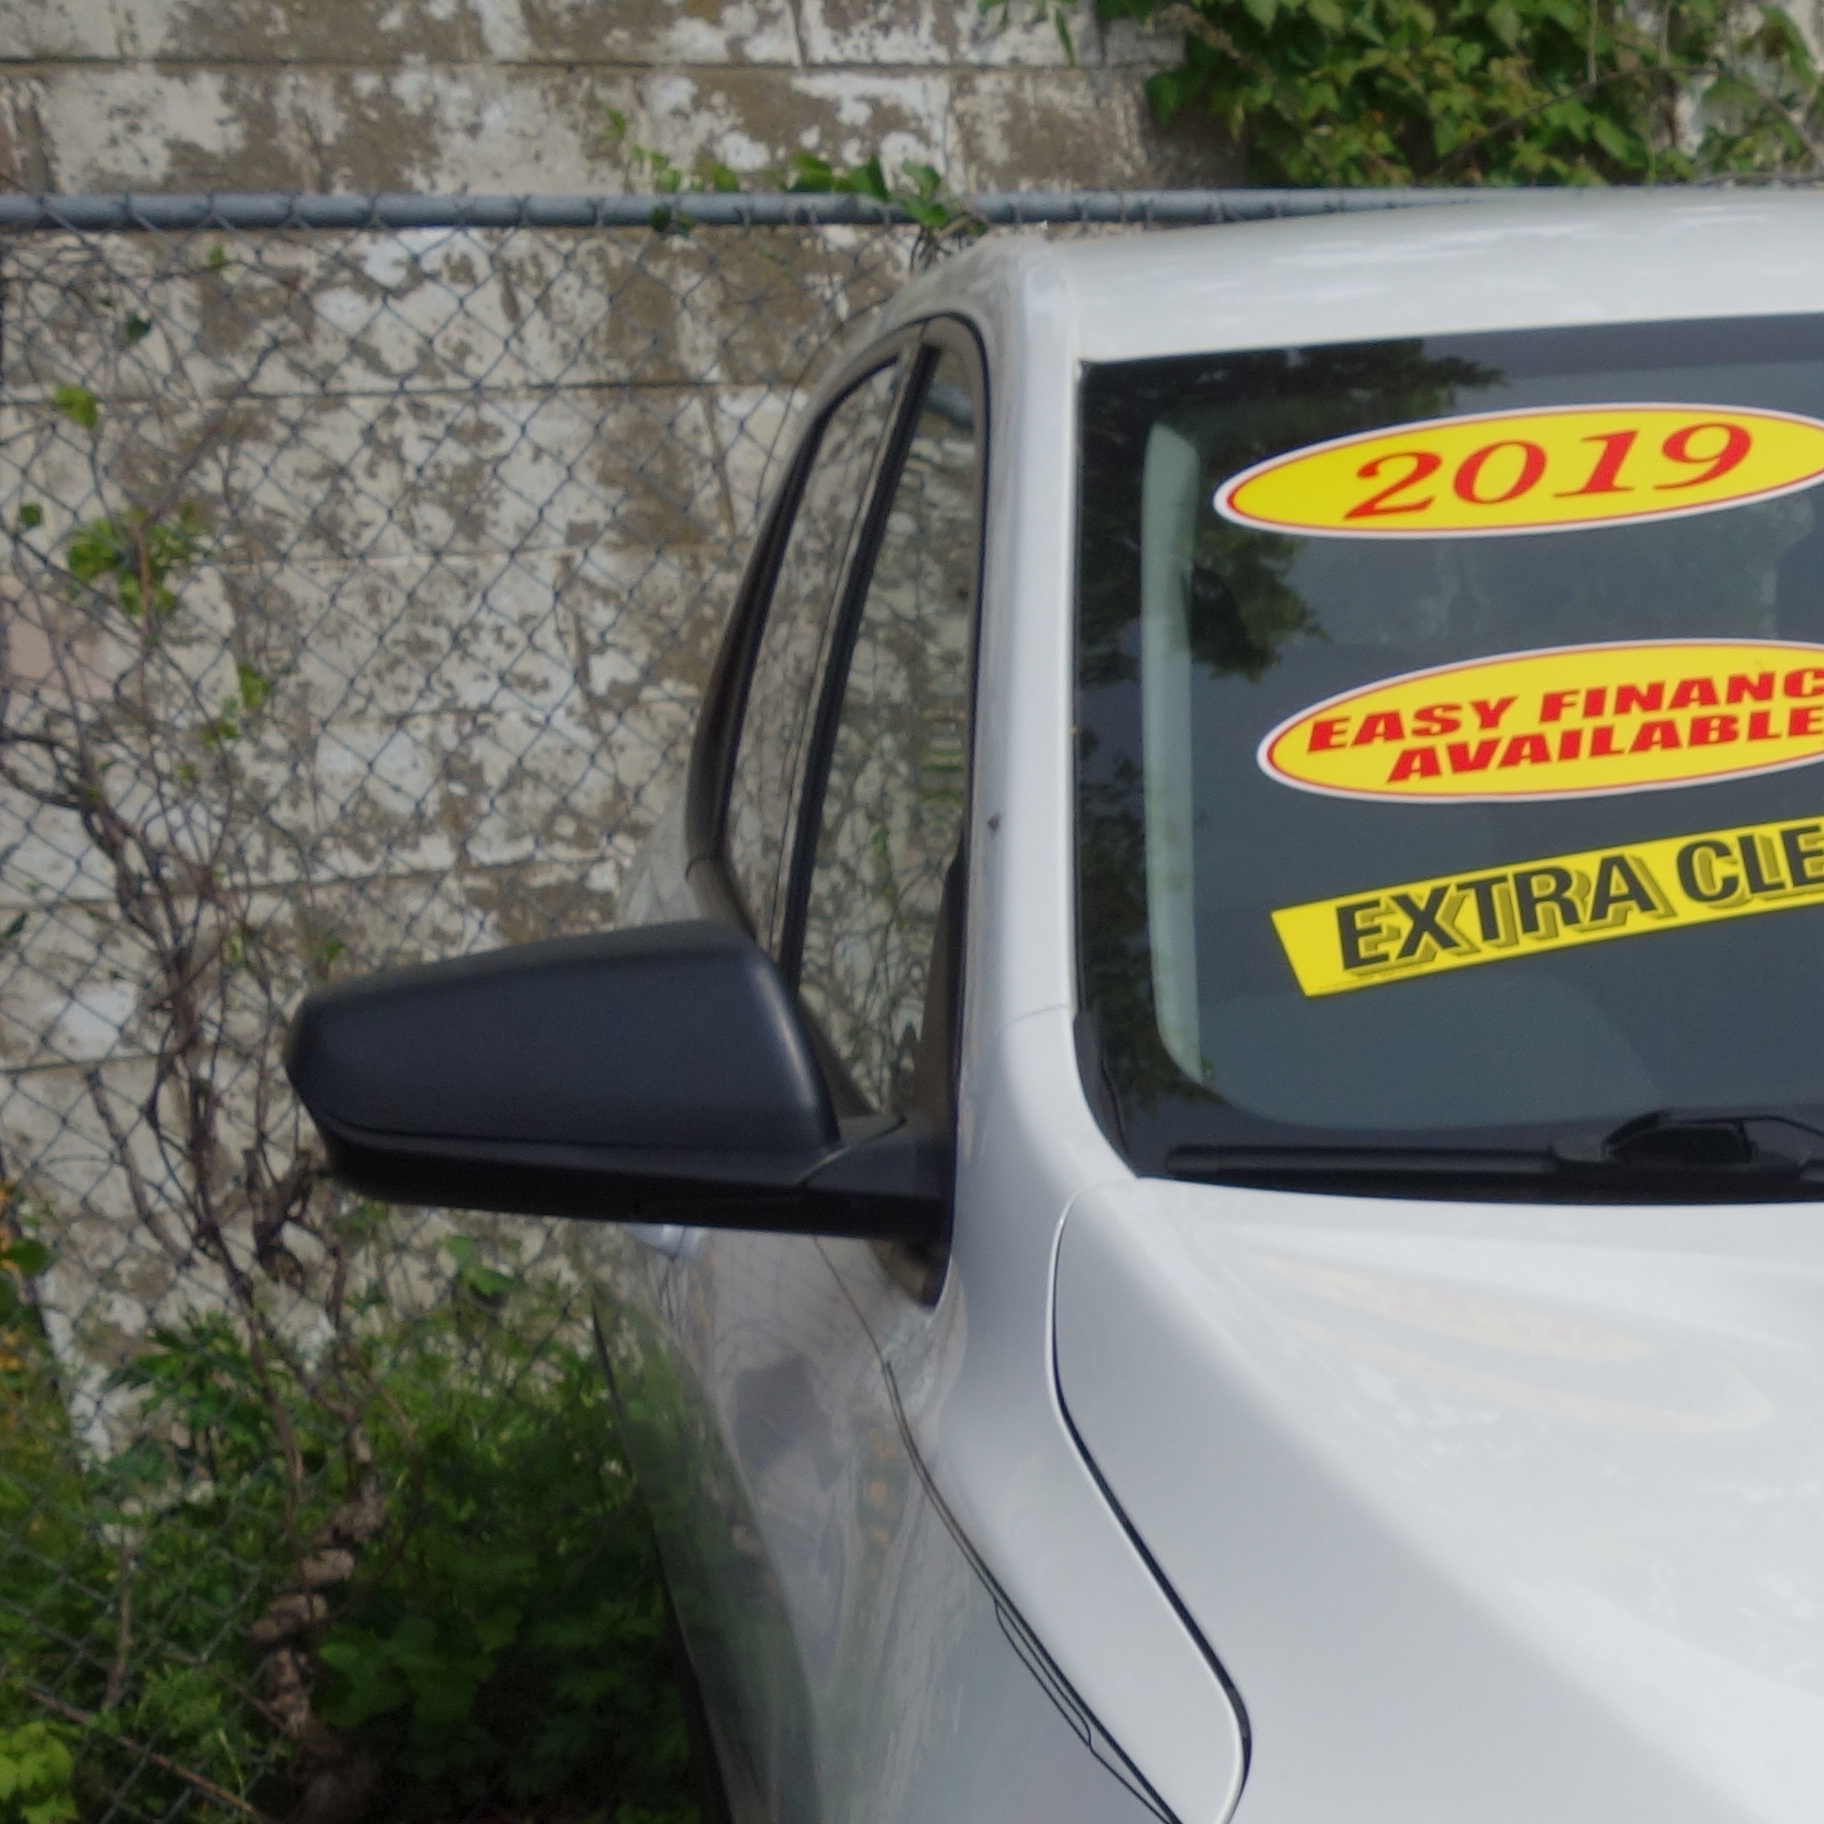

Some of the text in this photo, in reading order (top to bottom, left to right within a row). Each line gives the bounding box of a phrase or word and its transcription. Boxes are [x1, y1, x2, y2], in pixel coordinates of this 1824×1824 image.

[1343, 423, 1752, 520] 2019
[1306, 697, 1518, 752] EASY
[1335, 854, 1660, 973] EXTRA
